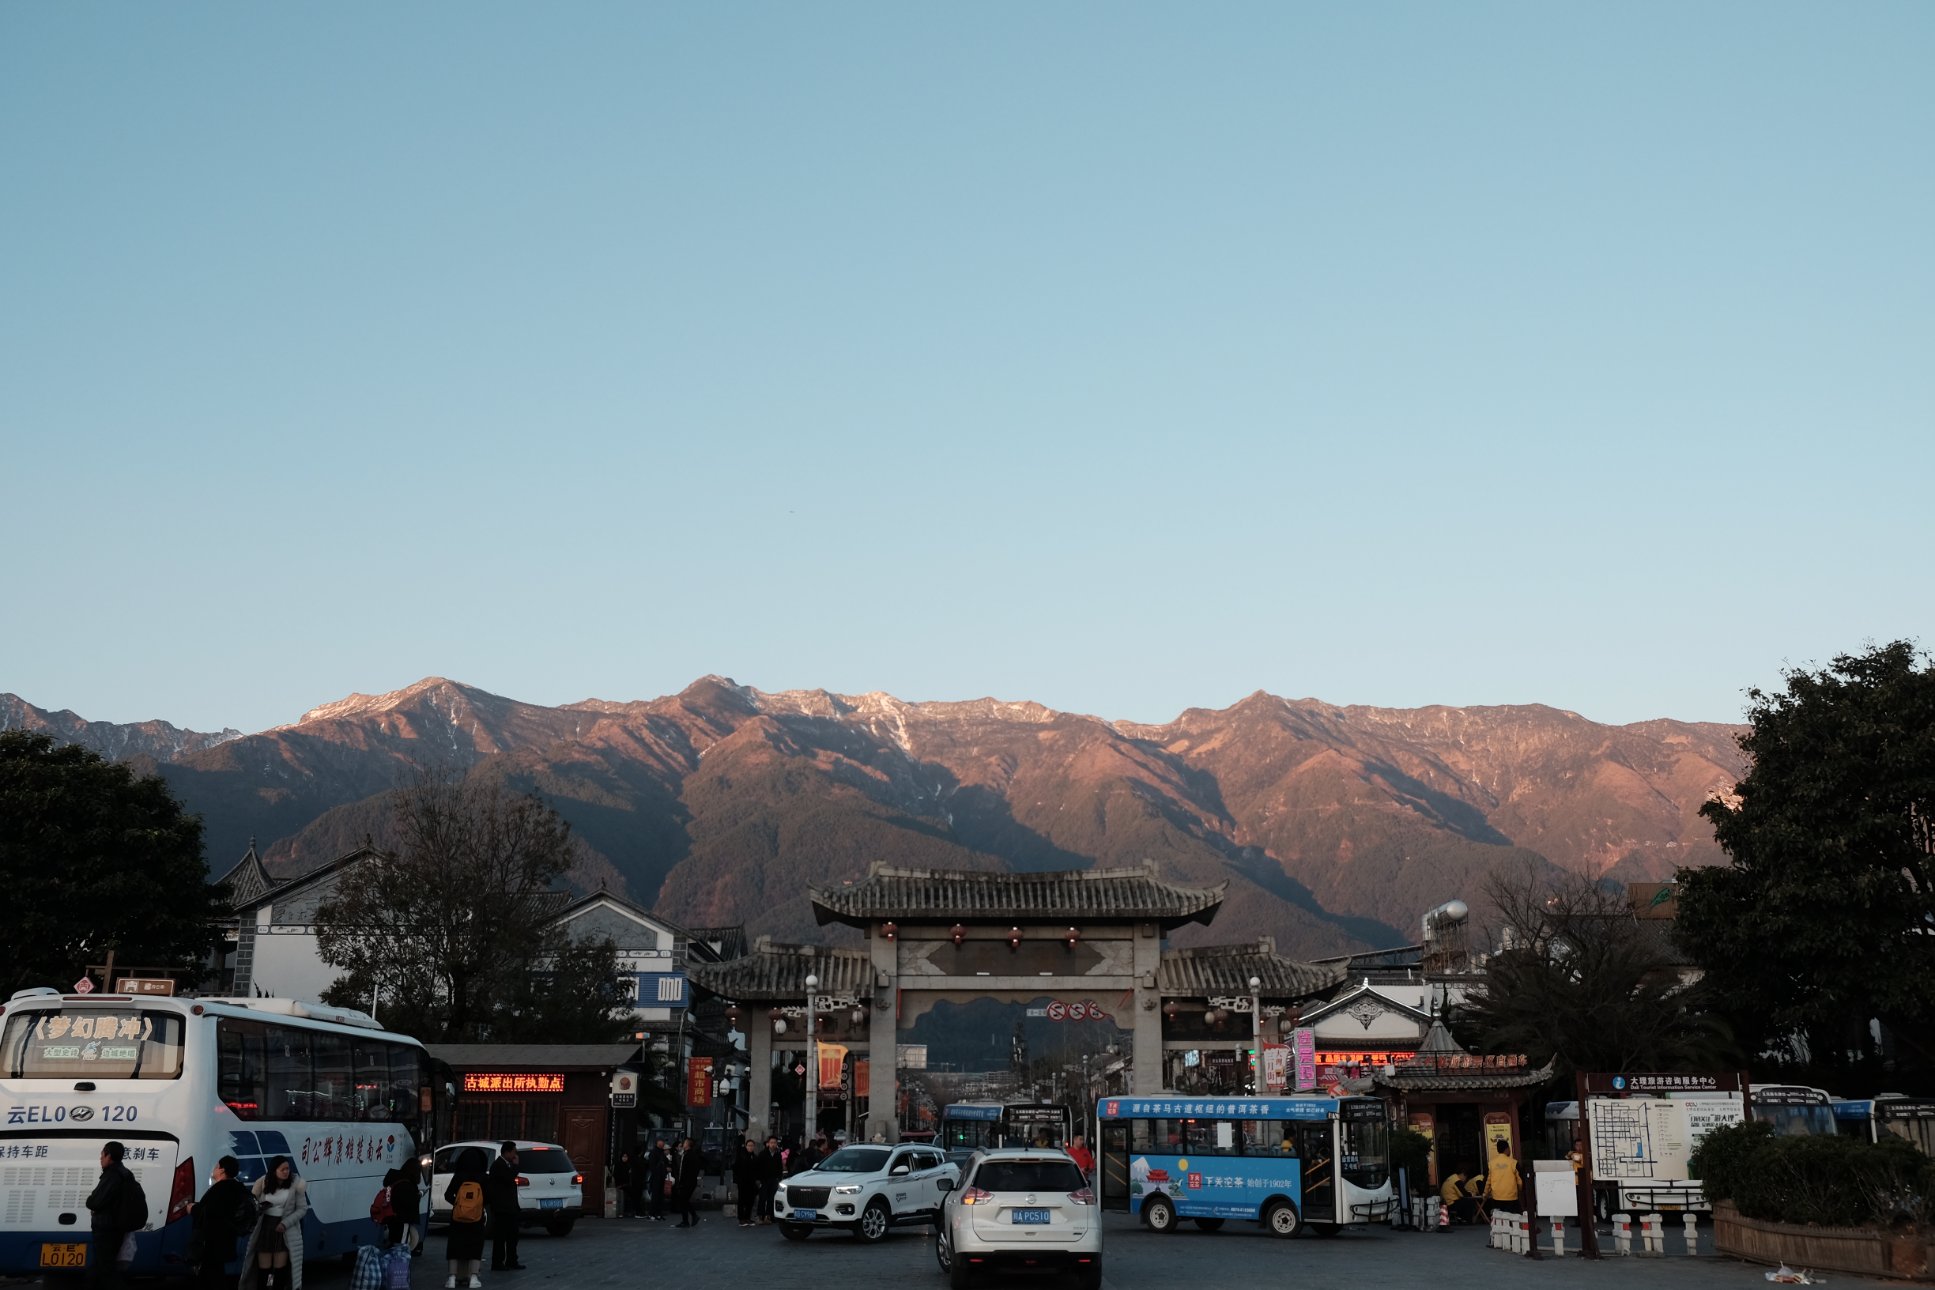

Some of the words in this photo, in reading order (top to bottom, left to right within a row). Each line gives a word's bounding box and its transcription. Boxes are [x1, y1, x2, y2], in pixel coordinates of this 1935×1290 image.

[466, 1077, 561, 1089] 古城派出所执勤点
[1631, 1076, 1716, 1085] 大理旅游咨询服务中心
[8, 1106, 65, 1124] 云EL0
[102, 1106, 138, 1122] 120
[1132, 1103, 1269, 1115] 源自茶马古道枢纽的普洱茶香
[1204, 1176, 1243, 1188] 下关沱茶
[1247, 1178, 1292, 1189] 始创于1902年
